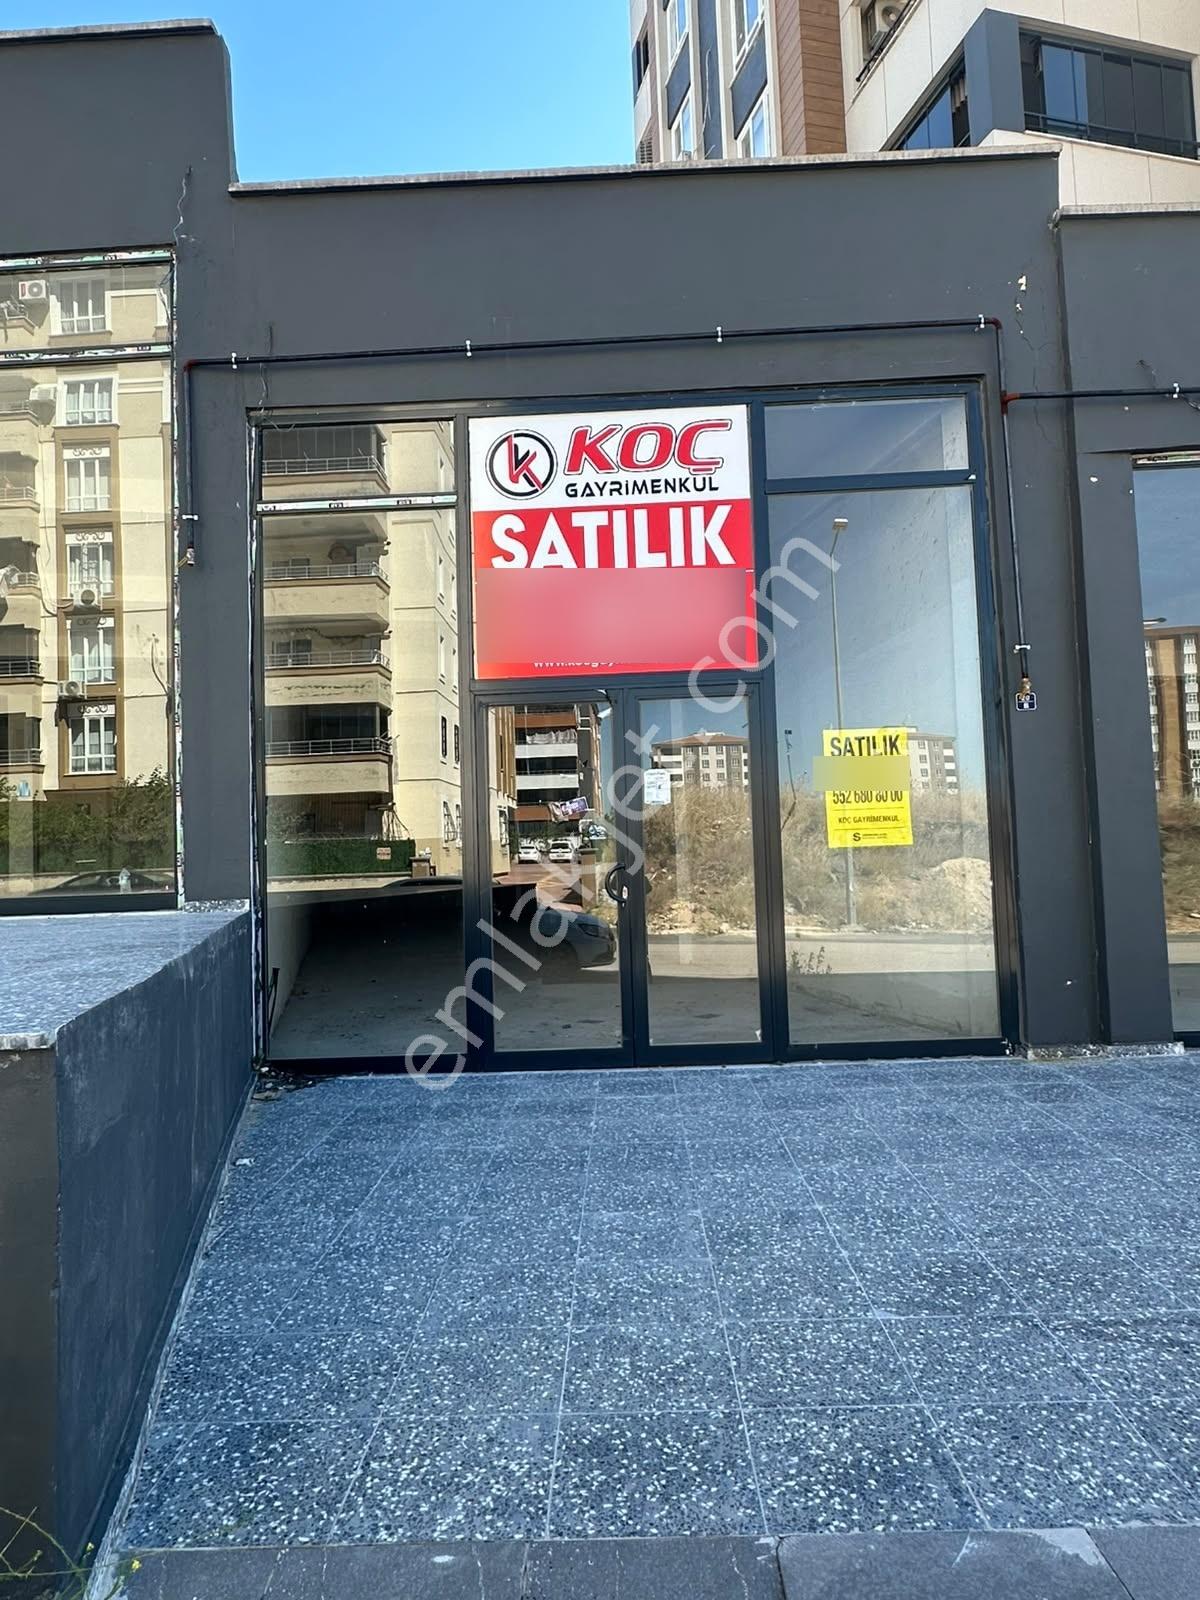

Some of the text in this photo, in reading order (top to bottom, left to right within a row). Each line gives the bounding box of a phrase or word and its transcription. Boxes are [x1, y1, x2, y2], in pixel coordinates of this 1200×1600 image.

[564, 419, 733, 475] KOÇ
[565, 477, 719, 498] GAYRİMENKUL
[491, 505, 736, 568] SATILIK
[830, 734, 900, 756] SATILIK
